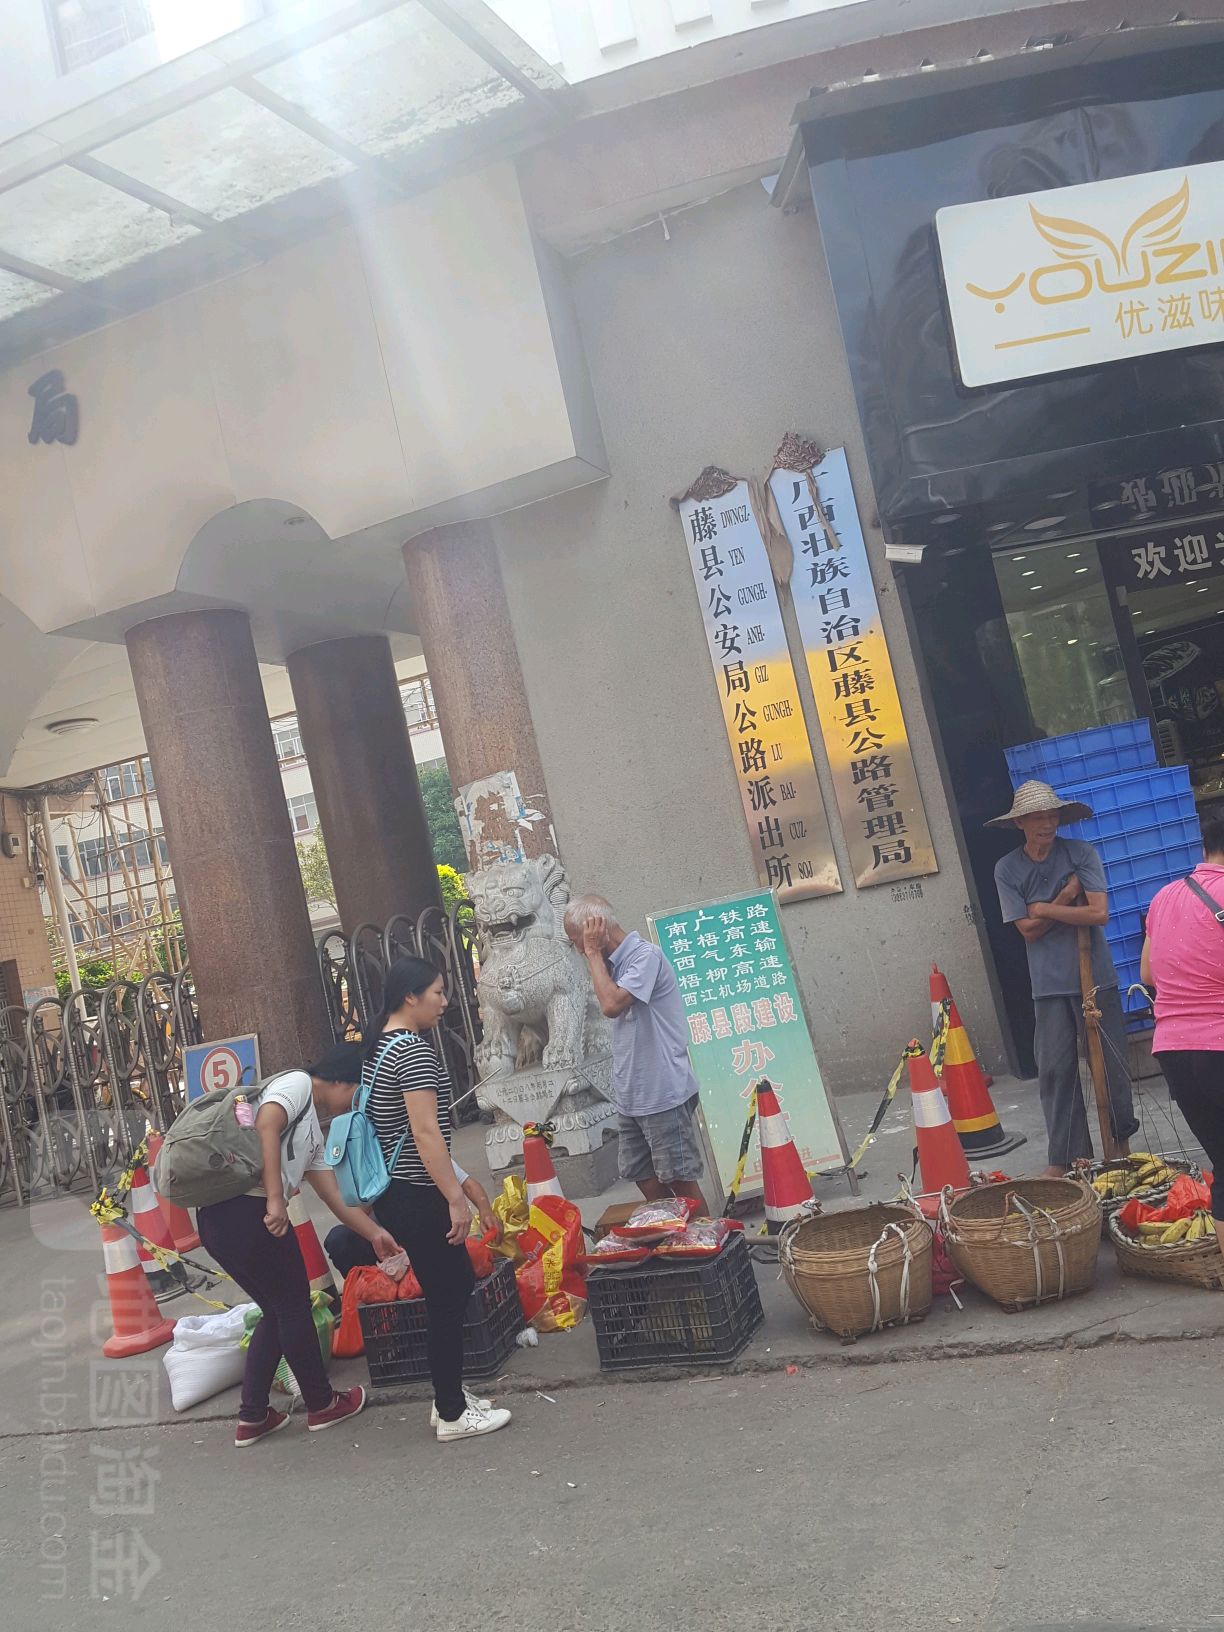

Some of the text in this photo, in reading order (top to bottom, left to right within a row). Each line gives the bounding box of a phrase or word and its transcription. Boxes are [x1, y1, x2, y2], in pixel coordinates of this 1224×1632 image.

[965, 239, 1224, 315] YOUZI
[28, 369, 79, 446] 局
[1131, 532, 1224, 579] 欢迎
[792, 472, 911, 871] 广西壮族自治区藤县公路管理局
[688, 506, 792, 889] 藤县公安局公路派出所
[728, 547, 746, 567] YEN
[755, 665, 769, 684] GIZ
[771, 743, 783, 761] LU
[798, 861, 814, 879] SOJ
[665, 903, 768, 938] 南广铁路
[670, 920, 774, 955] 贵梧高速
[673, 936, 776, 971] 西气东输
[679, 955, 783, 989] 梧柳高速
[682, 971, 787, 1006] 西江机场道路
[687, 992, 797, 1045] 藤县段建设
[212, 1059, 230, 1089] 5
